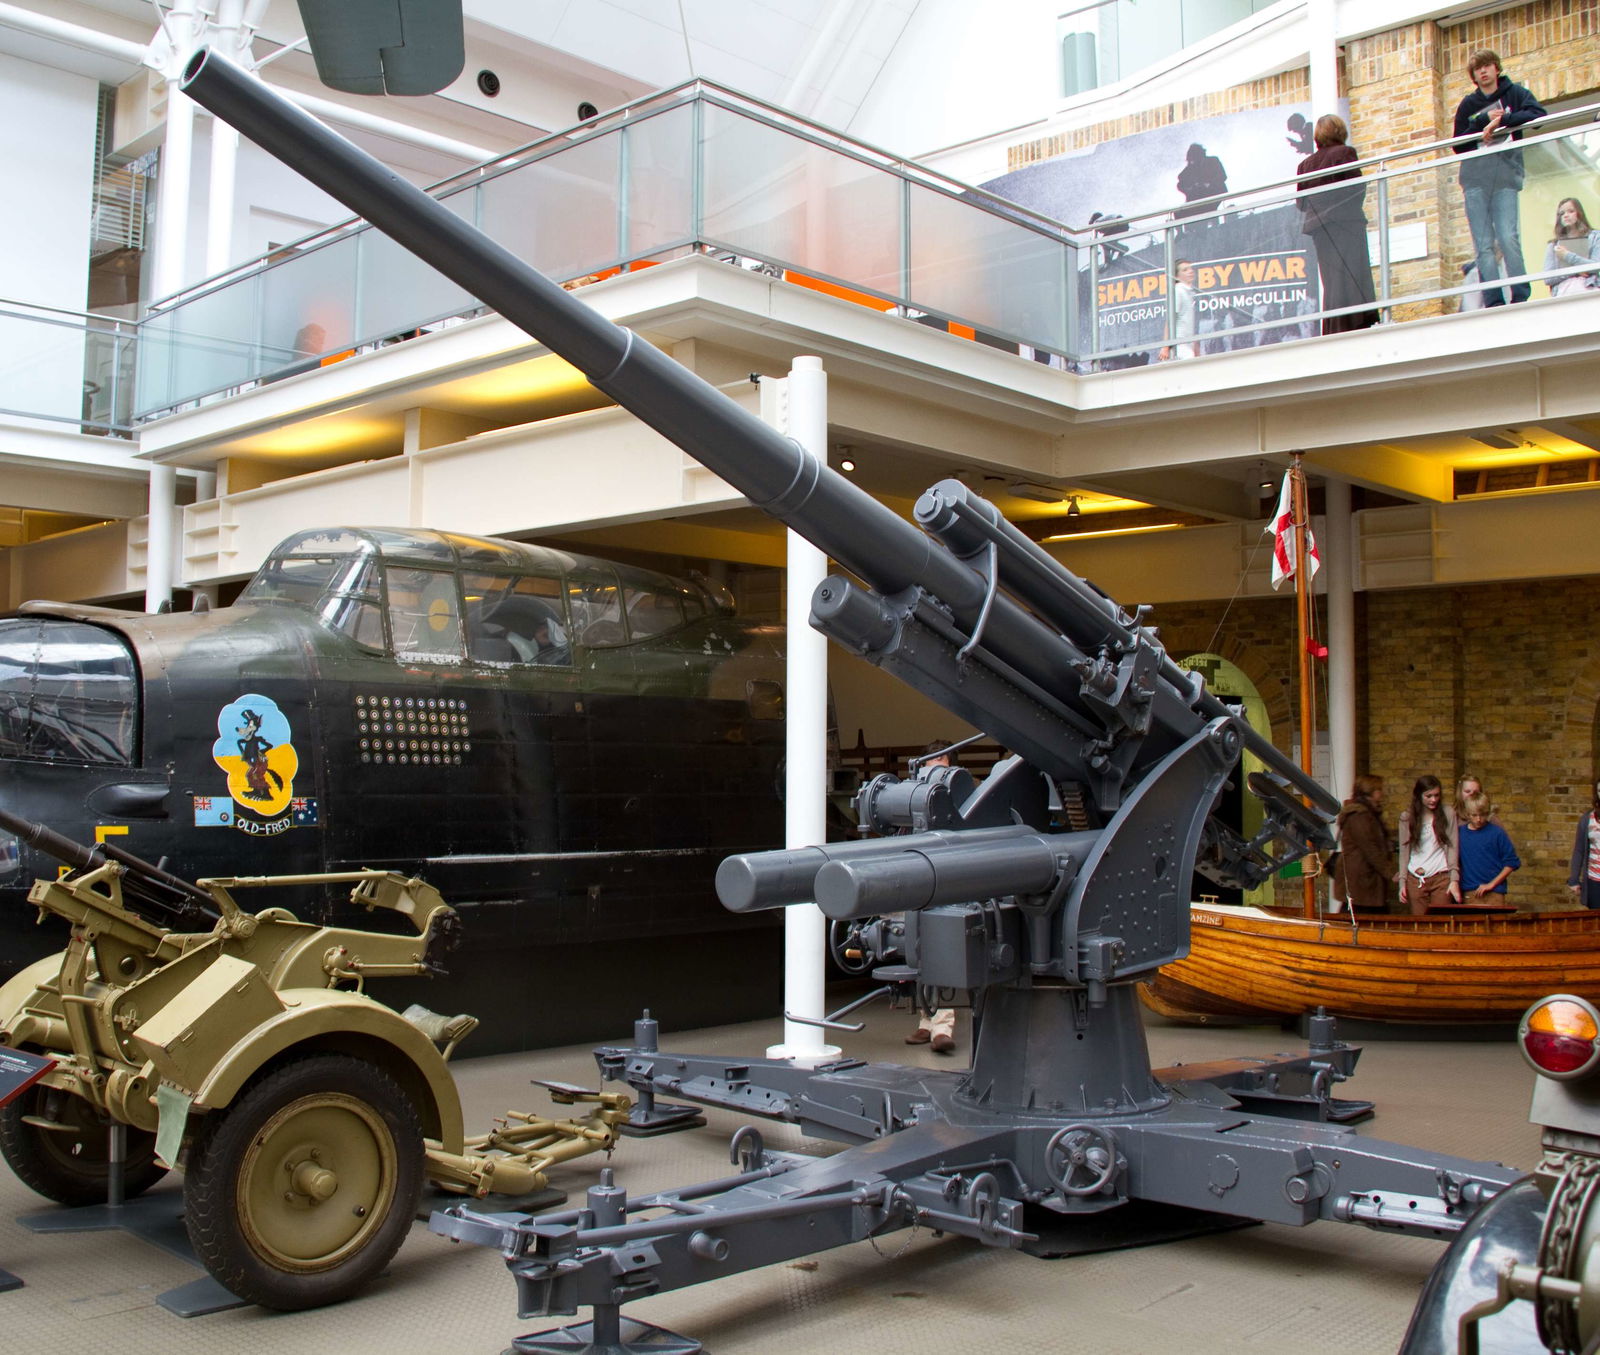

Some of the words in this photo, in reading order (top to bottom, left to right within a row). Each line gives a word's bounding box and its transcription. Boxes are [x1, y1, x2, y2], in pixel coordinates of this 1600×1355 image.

[1198, 264, 1235, 289] BY
[1239, 256, 1307, 284] WAR
[1199, 298, 1230, 312] DON
[1233, 289, 1307, 308] McCULLIN
[237, 818, 291, 835] OLD-FRED
[1191, 913, 1220, 926] AMZINE
